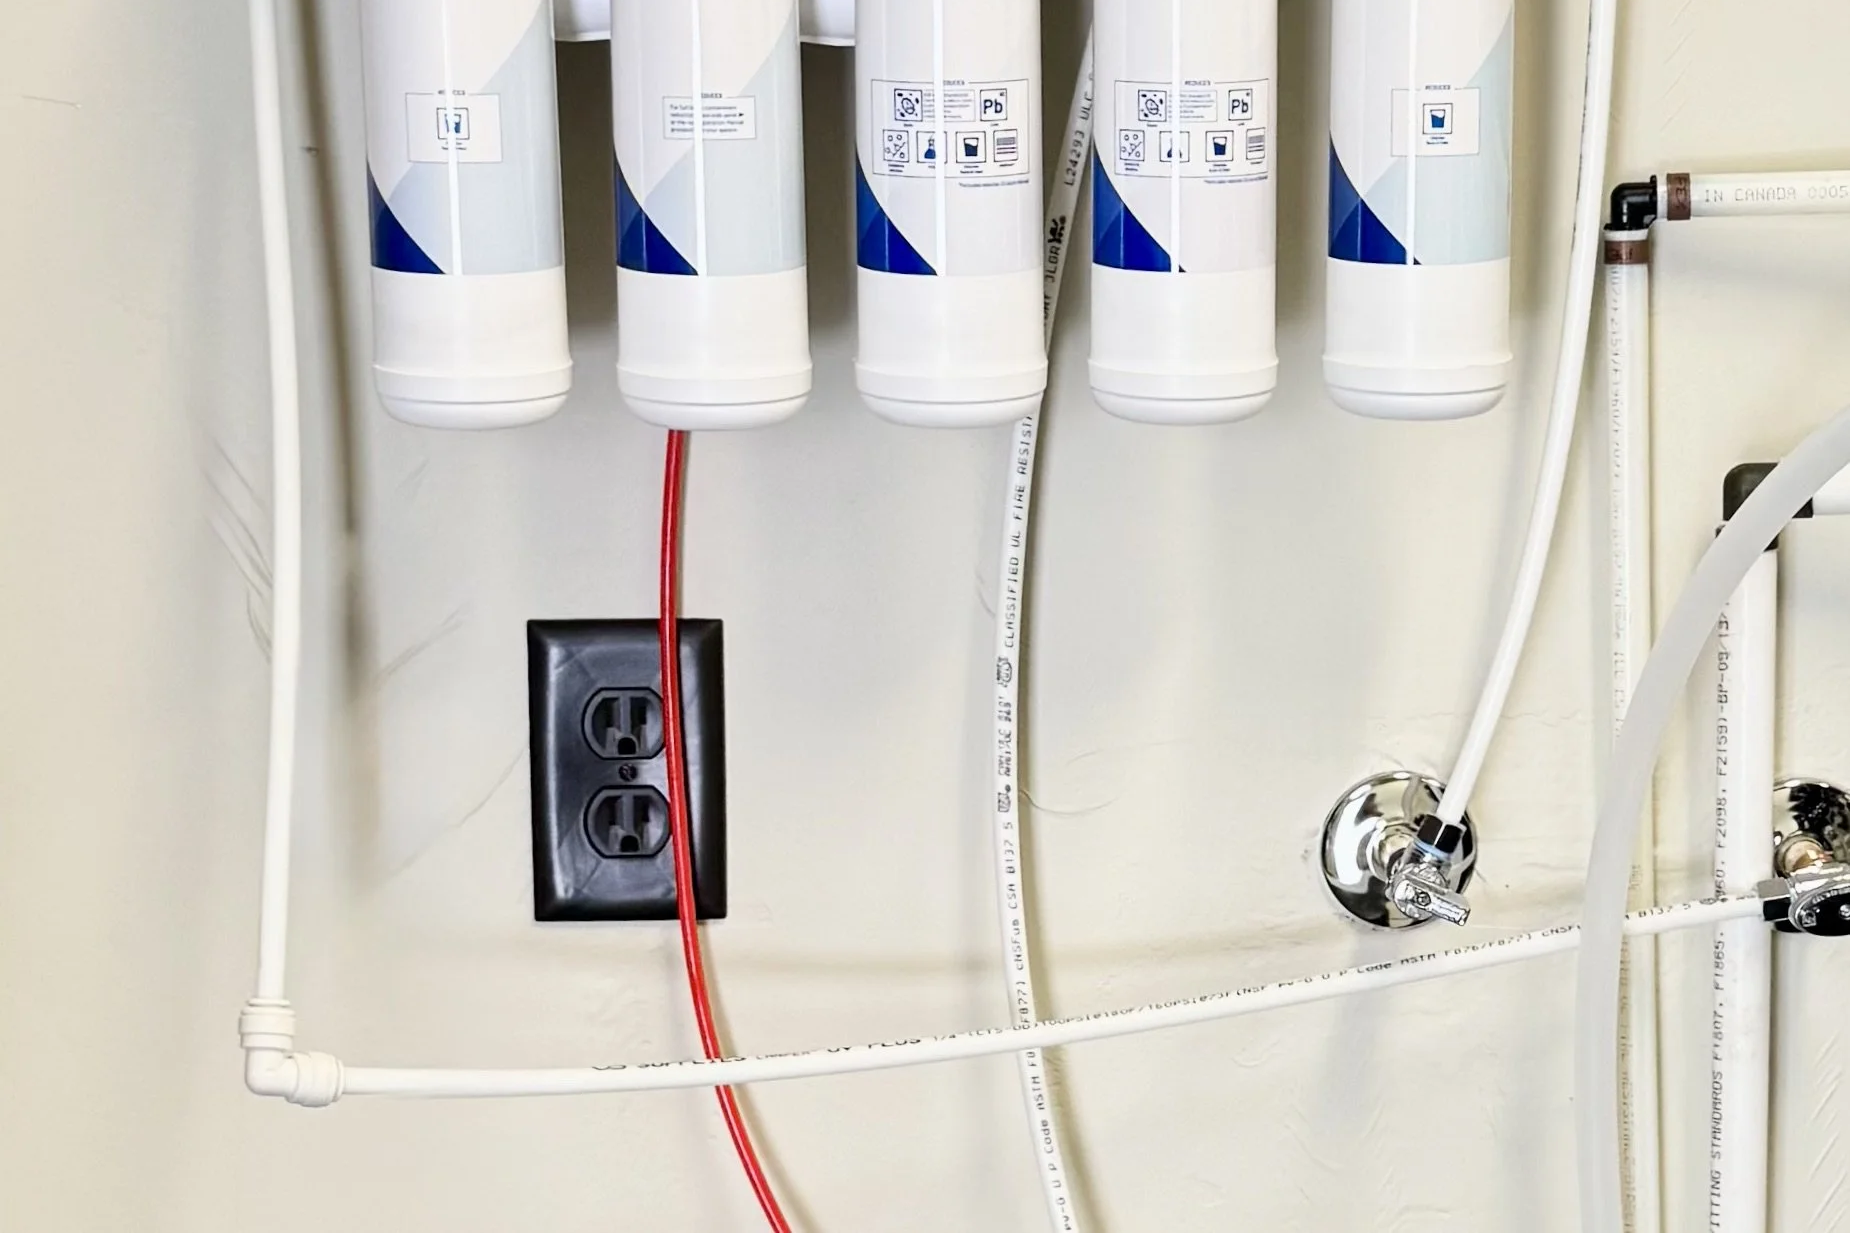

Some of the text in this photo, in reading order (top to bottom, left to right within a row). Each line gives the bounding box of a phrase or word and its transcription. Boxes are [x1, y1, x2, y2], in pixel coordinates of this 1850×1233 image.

[983, 99, 1003, 114] Pb
[1231, 99, 1249, 114] Pb
[1704, 189, 1723, 203] IN
[1735, 187, 1797, 202] CANADA
[1013, 485, 1025, 520] FIRE
[1010, 531, 1021, 548] UL
[1004, 557, 1020, 649] CLASSIFIED
[1003, 840, 1015, 874] B137
[1007, 884, 1018, 909] CSA
[1031, 1075, 1045, 1110] ASTM
[1711, 1070, 1723, 1160] STANDARDS
[1040, 1119, 1054, 1154] Code
[1710, 1169, 1721, 1233] ITTING
